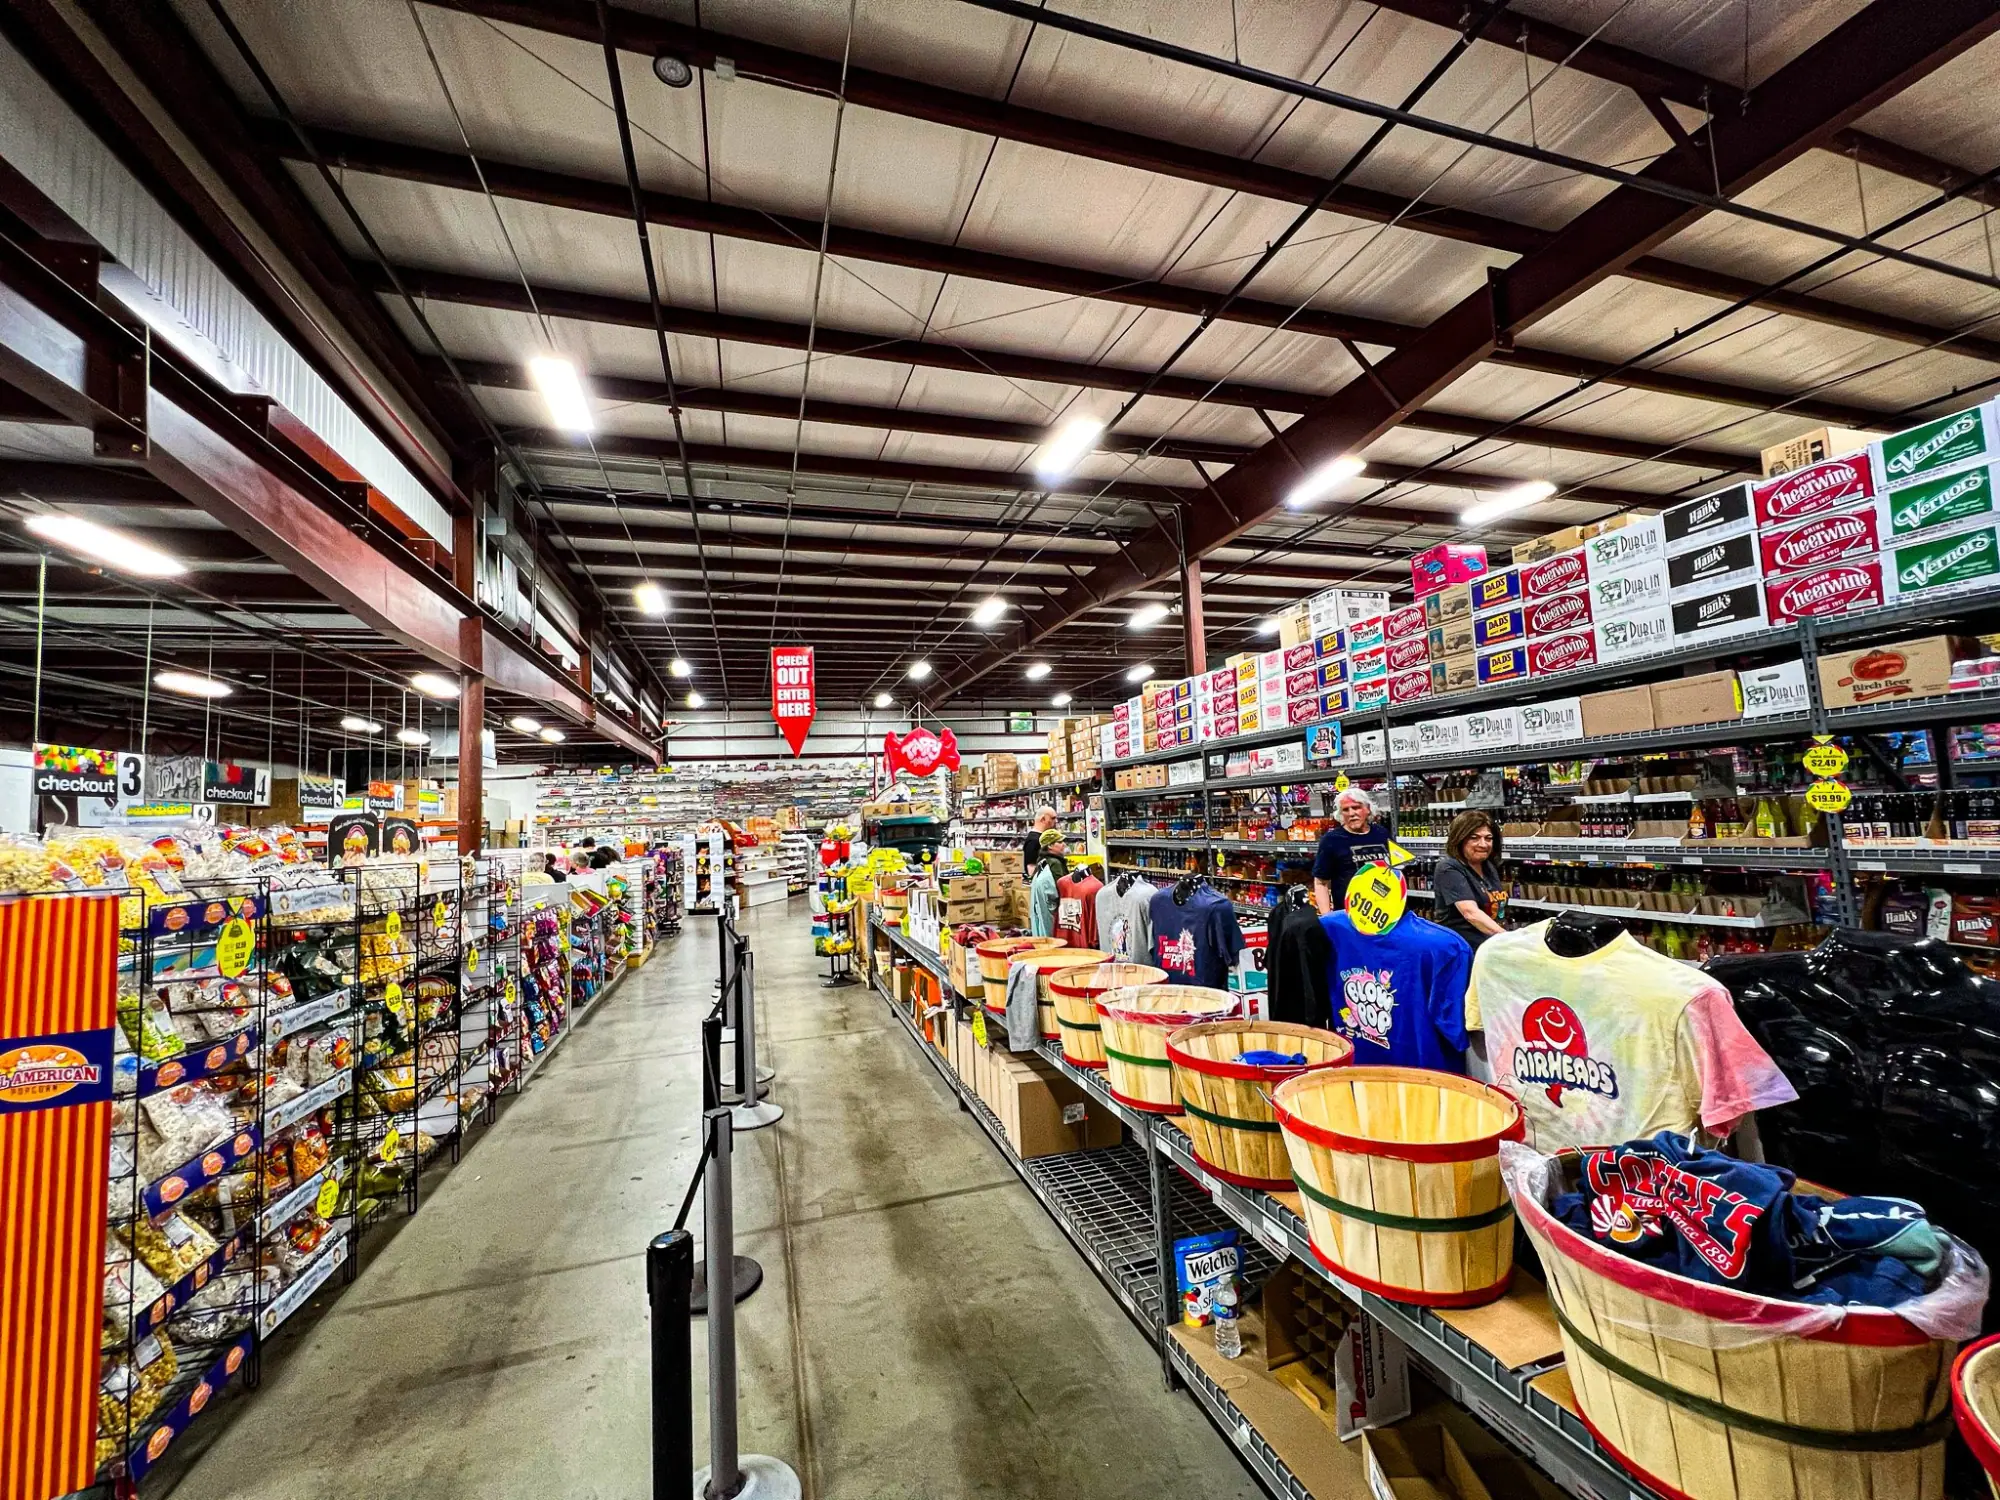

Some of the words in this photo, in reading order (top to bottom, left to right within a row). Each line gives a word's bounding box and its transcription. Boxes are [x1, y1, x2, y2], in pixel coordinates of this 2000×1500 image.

[1887, 413, 1976, 474] Vernors
[1767, 465, 1857, 517] Cheerwine
[1894, 471, 1984, 528] Vernors
[1689, 497, 1721, 524] Hank's
[1620, 529, 1657, 553] DUBLIN
[1775, 520, 1867, 566] Cheerwine
[1693, 545, 1726, 571] Hank's
[1900, 533, 1991, 586] Vernors
[1485, 578, 1506, 593] DAD'S
[1528, 559, 1582, 594] Cheerwine
[1624, 573, 1660, 595] DUBLIN
[1780, 572, 1872, 615] Cheerwine
[1532, 598, 1585, 631] Cheerwine
[1699, 594, 1731, 619] Hank's
[1488, 615, 1509, 631] DAD'S
[1629, 618, 1666, 638] DUBLIN
[776, 655, 810, 666] CHECK
[1491, 653, 1512, 667] DAD'S
[1536, 638, 1590, 669] Cheerwine
[777, 667, 809, 685] OUT
[1852, 682, 1882, 692] Birch
[1884, 678, 1912, 688] Beer
[777, 688, 810, 701] ENTER
[1769, 684, 1806, 700] DUBLIN
[777, 702, 811, 717] HERE
[1543, 709, 1575, 724] DUBLIN
[1485, 717, 1513, 732] DUBLIN
[38, 775, 115, 793] checkout
[122, 756, 142, 797] 3
[206, 787, 253, 801] checkout
[256, 775, 267, 802] 4
[301, 793, 333, 806] checkout
[334, 784, 344, 807] 5
[370, 798, 395, 809] checkout
[397, 788, 403, 809] 6
[1812, 795, 1842, 803] $19.99
[1352, 852, 1378, 863] SEAN'S
[1350, 892, 1390, 930] $19.99
[1885, 910, 1918, 924] Hank's
[1957, 917, 1993, 932] Hank's
[1346, 980, 1394, 1011] BLOW
[1357, 1002, 1393, 1035] POP
[12, 1065, 100, 1086] AMERICAN
[1513, 1047, 1620, 1100] AIRHEADS
[10, 1085, 59, 1096] POPCORN
[1666, 1209, 1700, 1240] Since
[1699, 1239, 1733, 1271] 1895
[1187, 1250, 1237, 1279] Welch's
